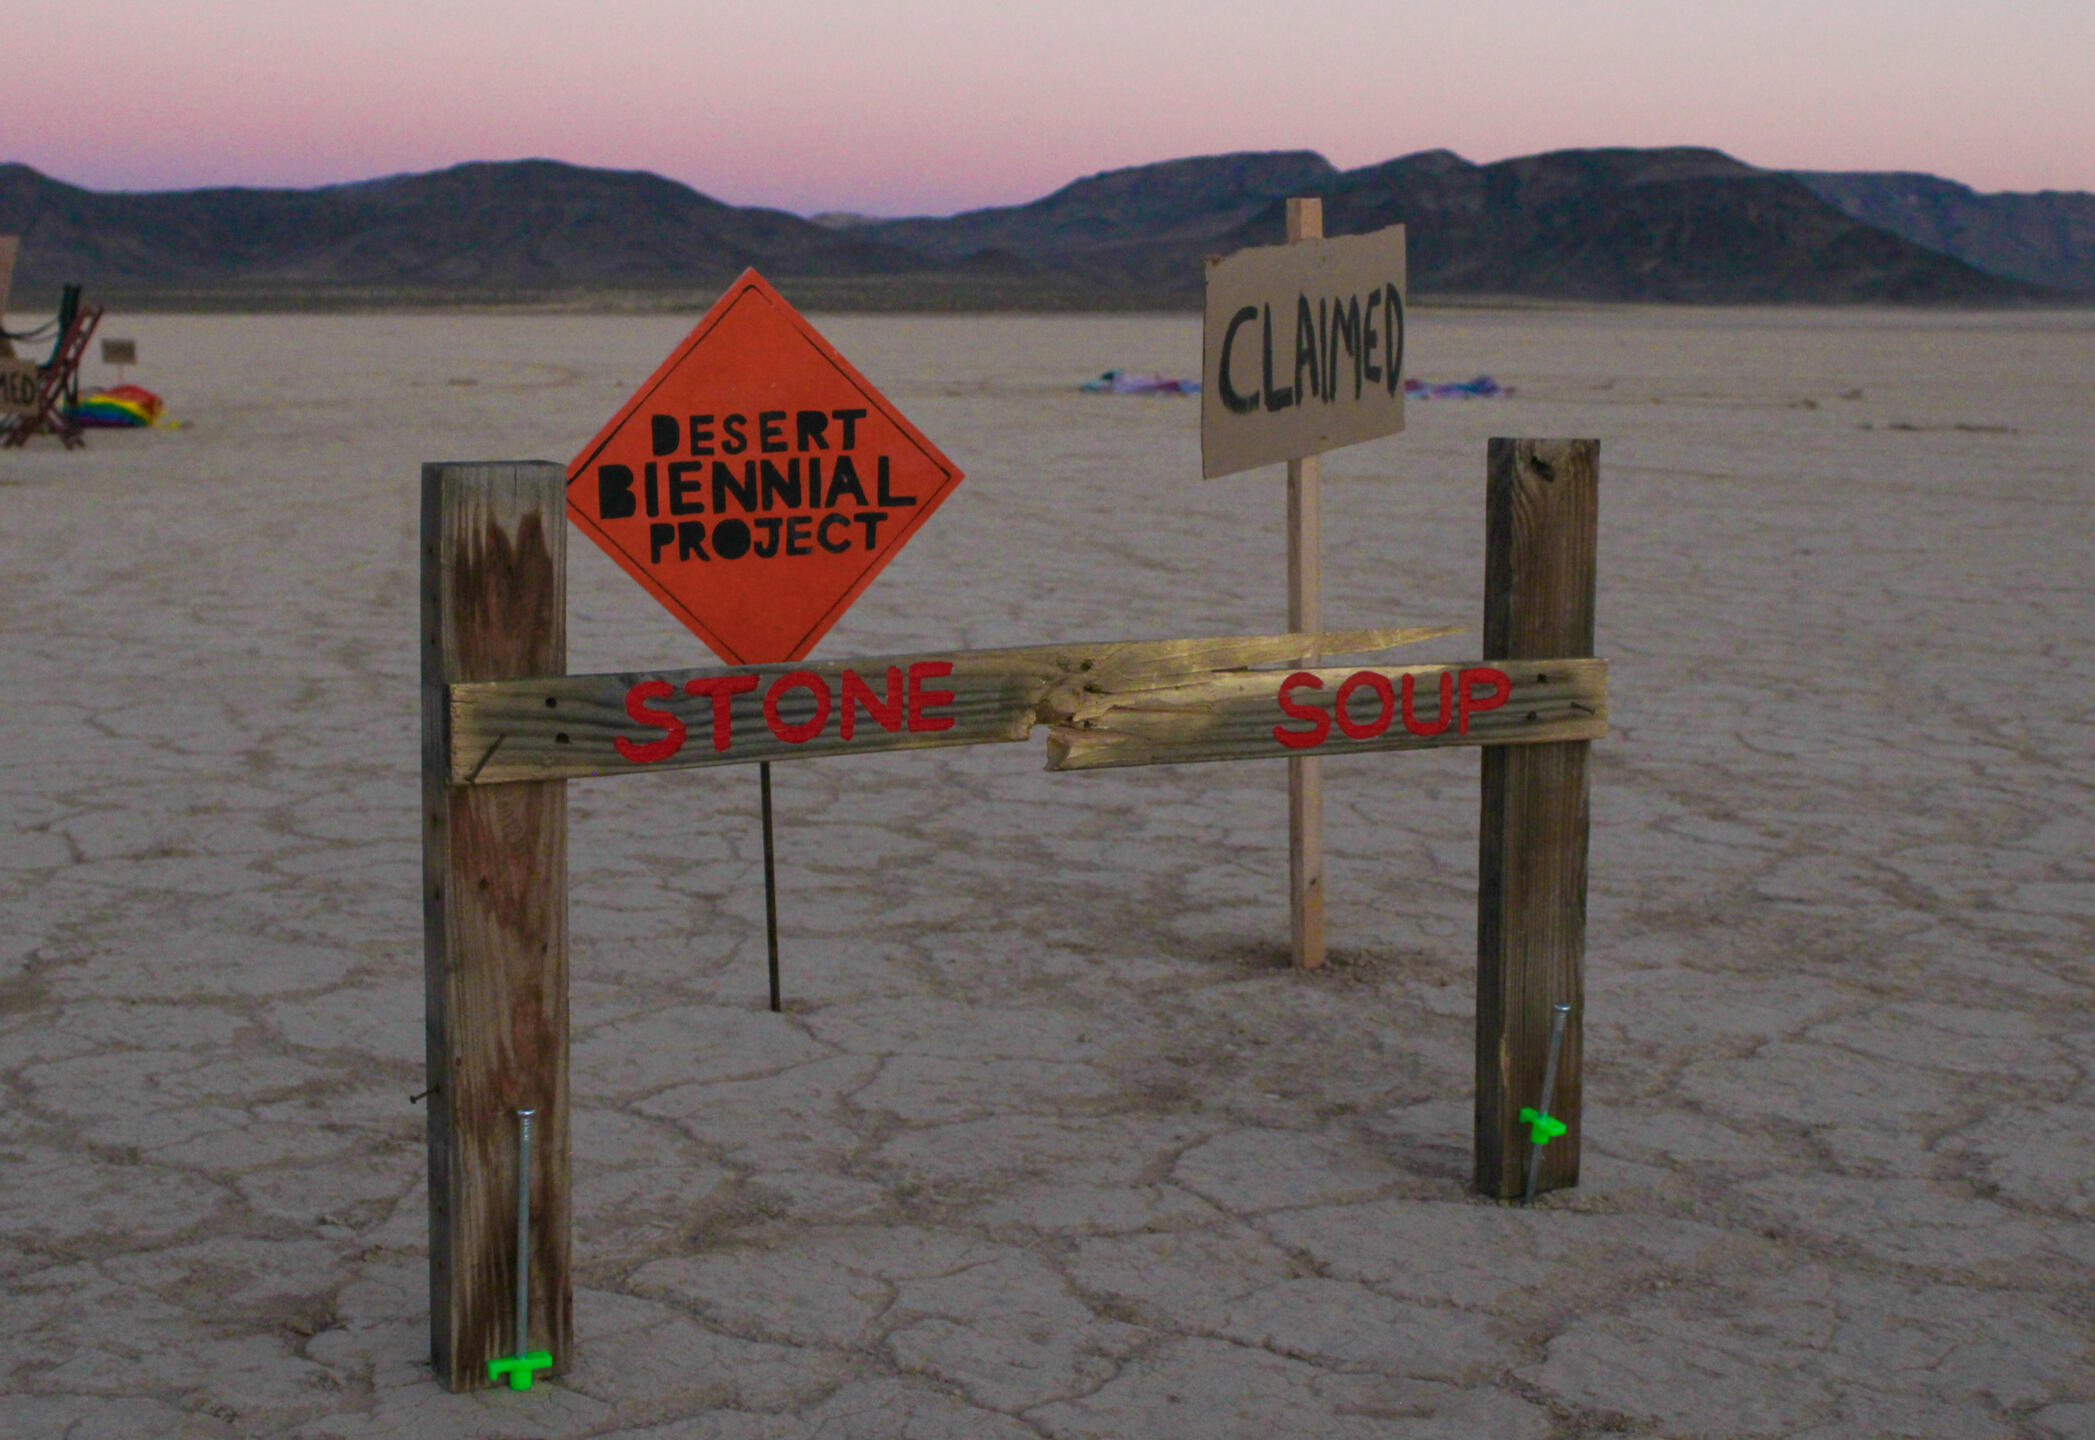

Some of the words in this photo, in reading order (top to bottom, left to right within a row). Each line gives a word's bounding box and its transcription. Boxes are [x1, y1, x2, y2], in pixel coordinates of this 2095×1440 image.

[1218, 282, 1404, 415] CLAIMED
[651, 409, 867, 456] DESERT
[598, 455, 917, 519] BIENNIAL
[650, 512, 888, 564] PROJECT
[613, 660, 955, 763] STONE
[1272, 667, 1513, 750] SOUP
